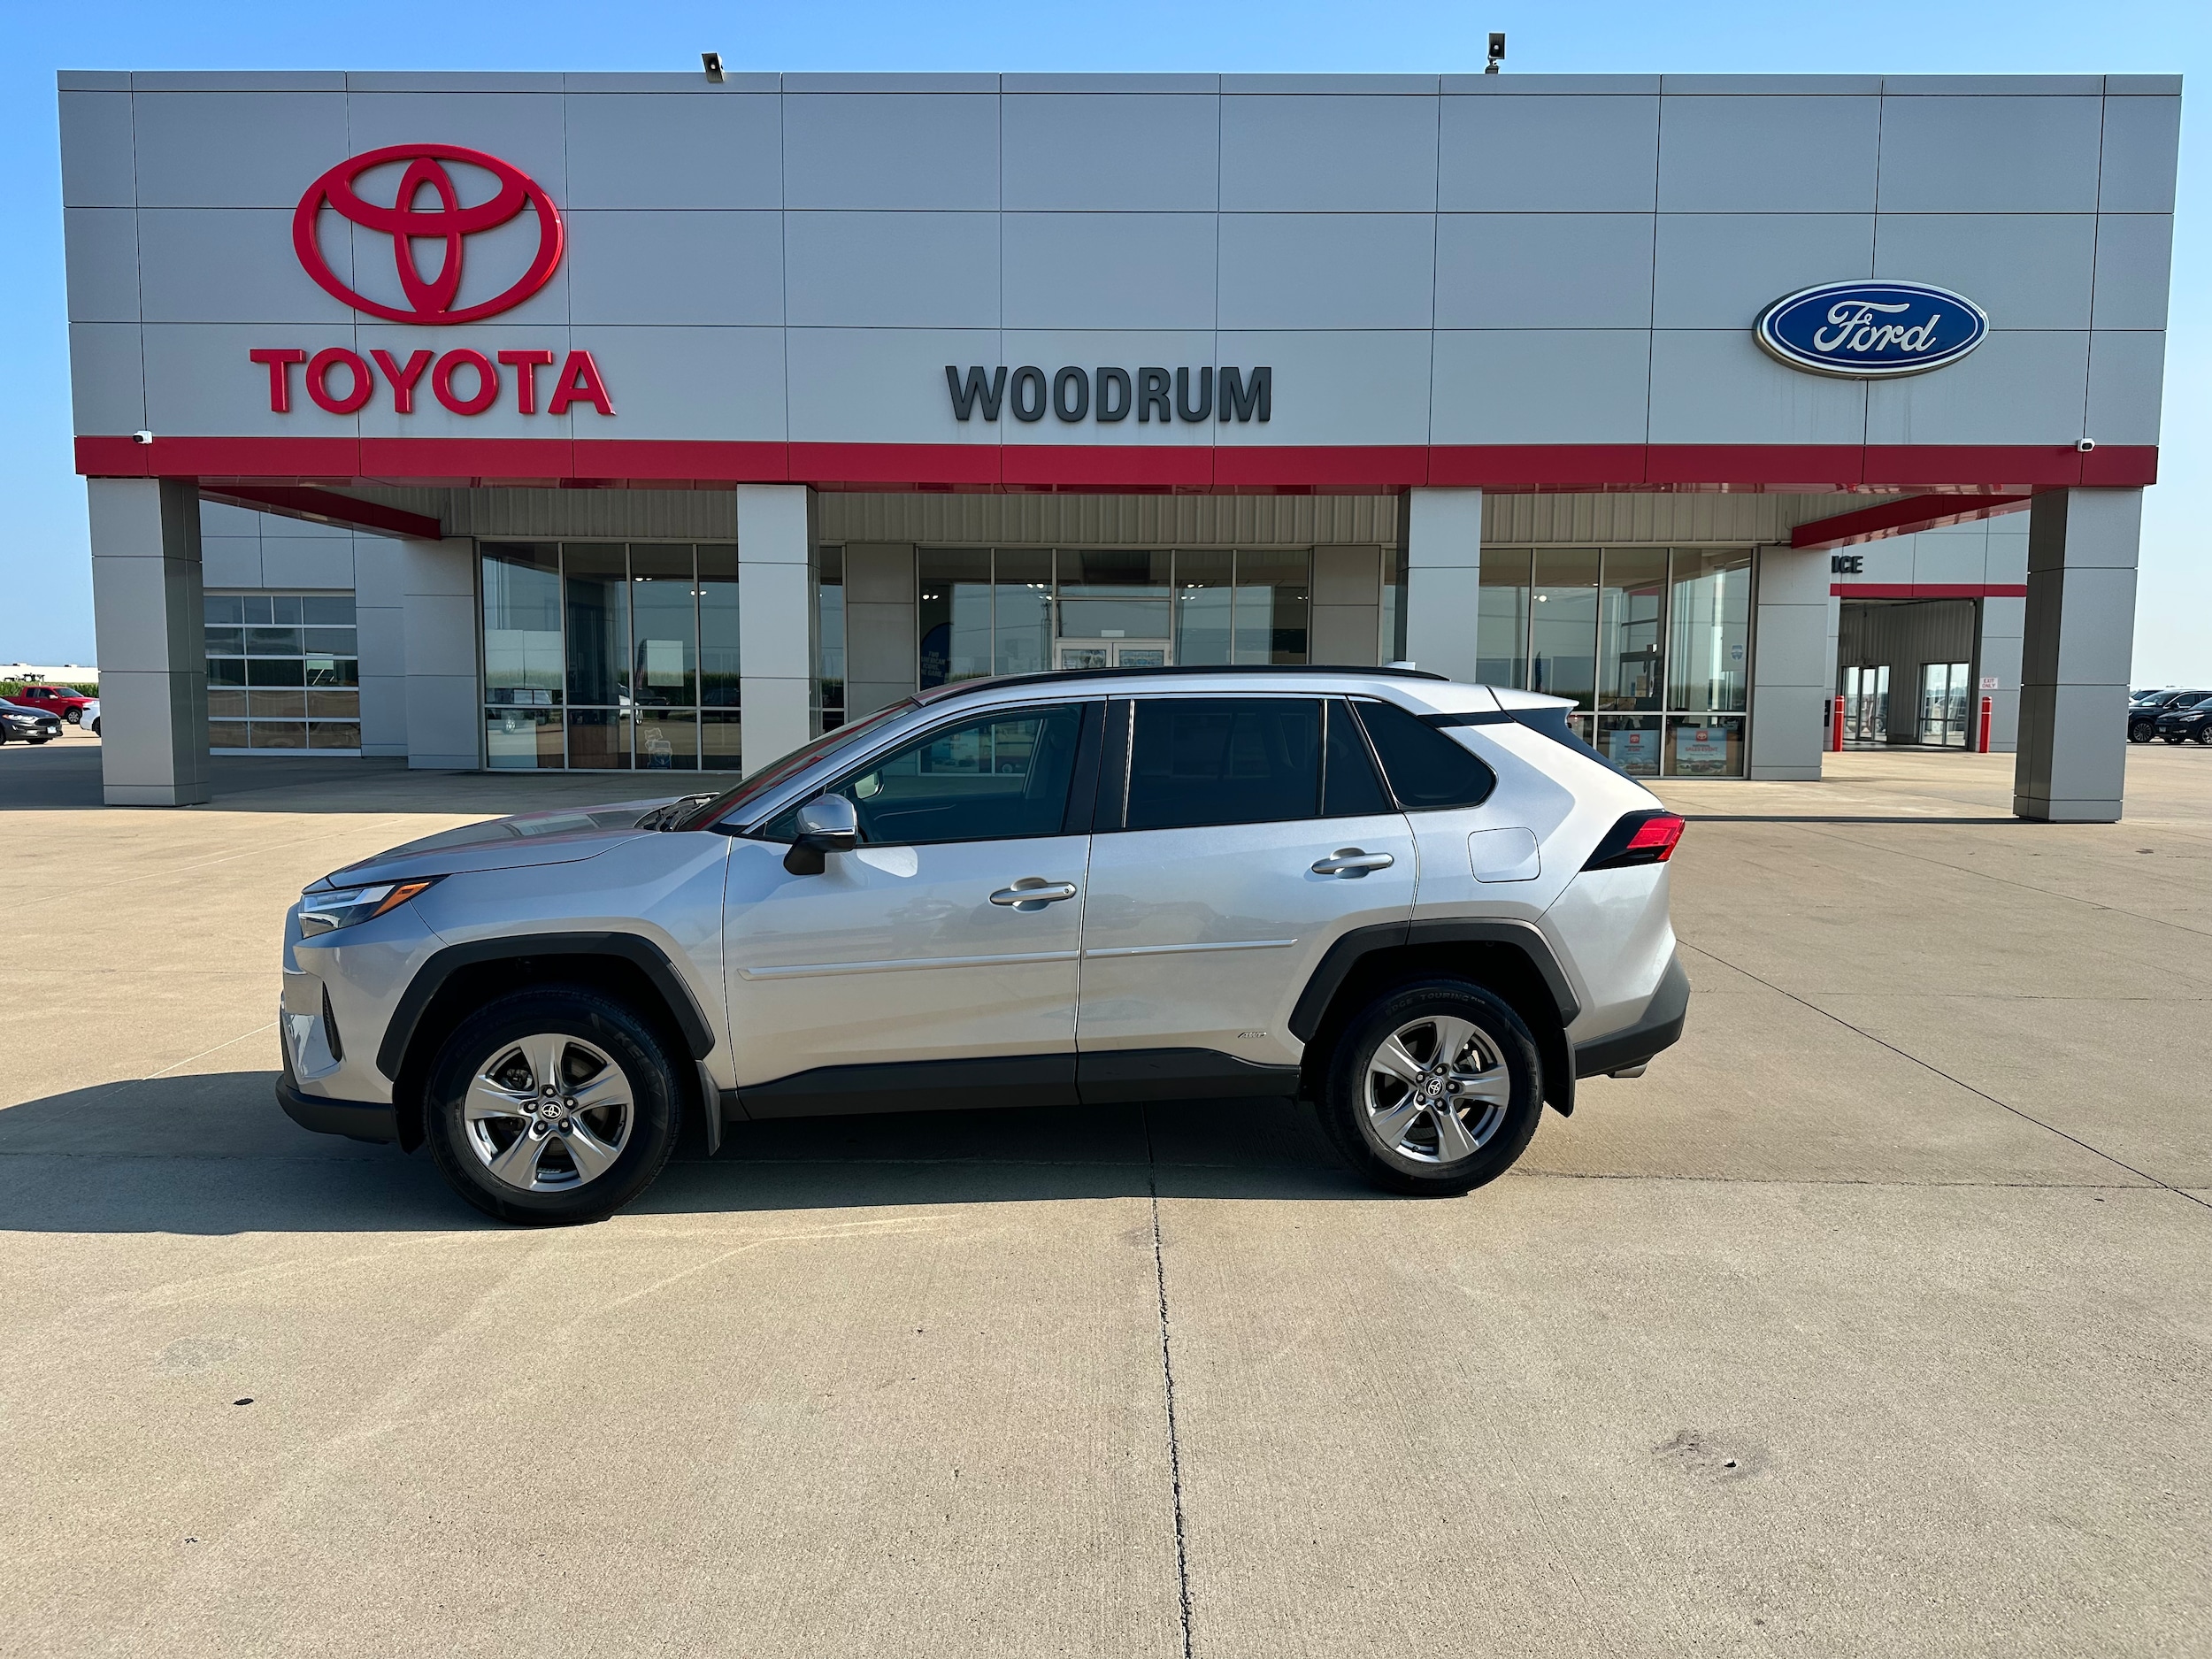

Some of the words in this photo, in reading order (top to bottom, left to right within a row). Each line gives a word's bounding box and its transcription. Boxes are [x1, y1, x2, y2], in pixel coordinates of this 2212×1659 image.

[1813, 300, 1940, 352] Ford
[250, 347, 616, 416] TOYOTA
[945, 365, 1271, 422] WOODRUM
[1419, 992, 1469, 1002] TOURING
[612, 1031, 664, 1098] KELLY
